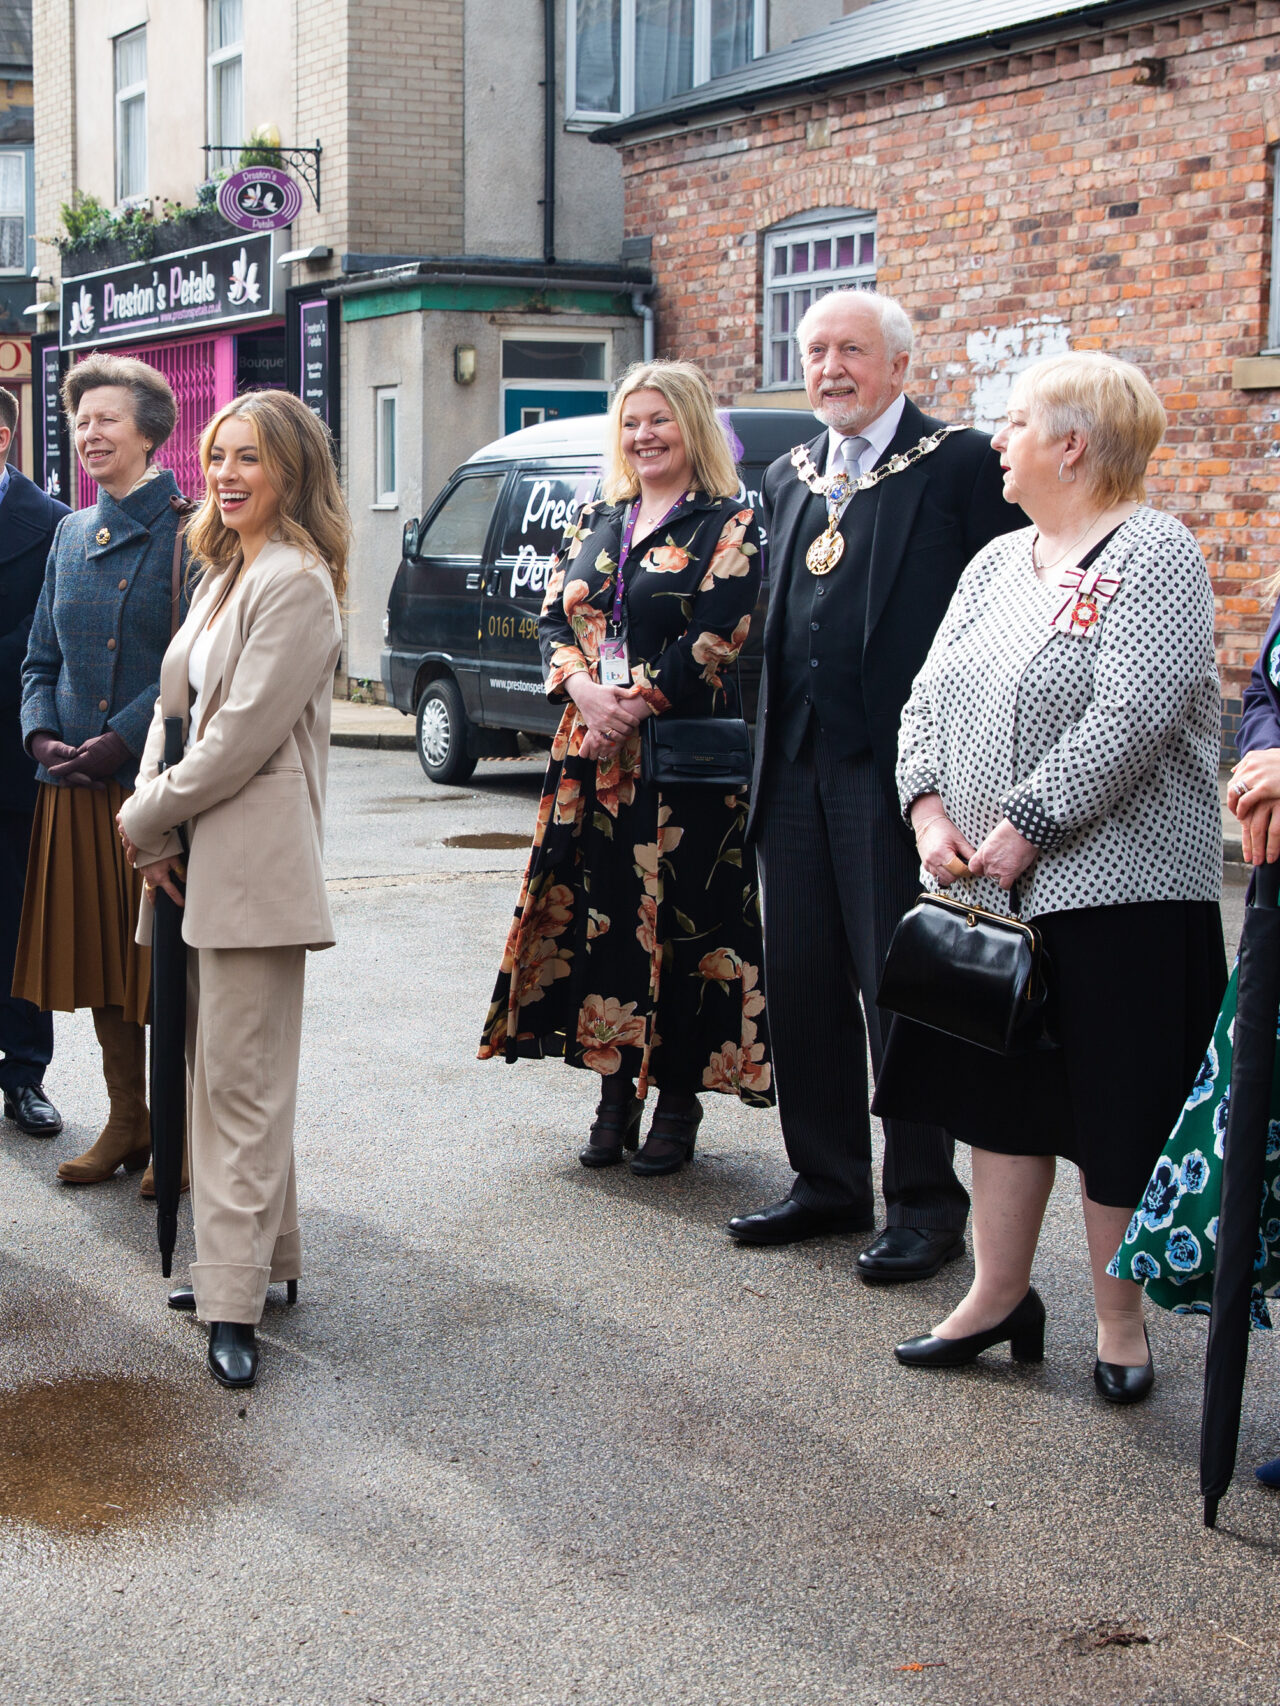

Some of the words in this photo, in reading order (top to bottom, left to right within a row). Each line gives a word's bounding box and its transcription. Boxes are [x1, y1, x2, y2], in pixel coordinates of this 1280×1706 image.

[242, 171, 277, 182] Preston's
[252, 218, 275, 229] Petals
[104, 271, 166, 321] Preston's
[170, 261, 216, 308] Petals
[488, 615, 515, 637] 0161
[518, 617, 539, 640] 496
